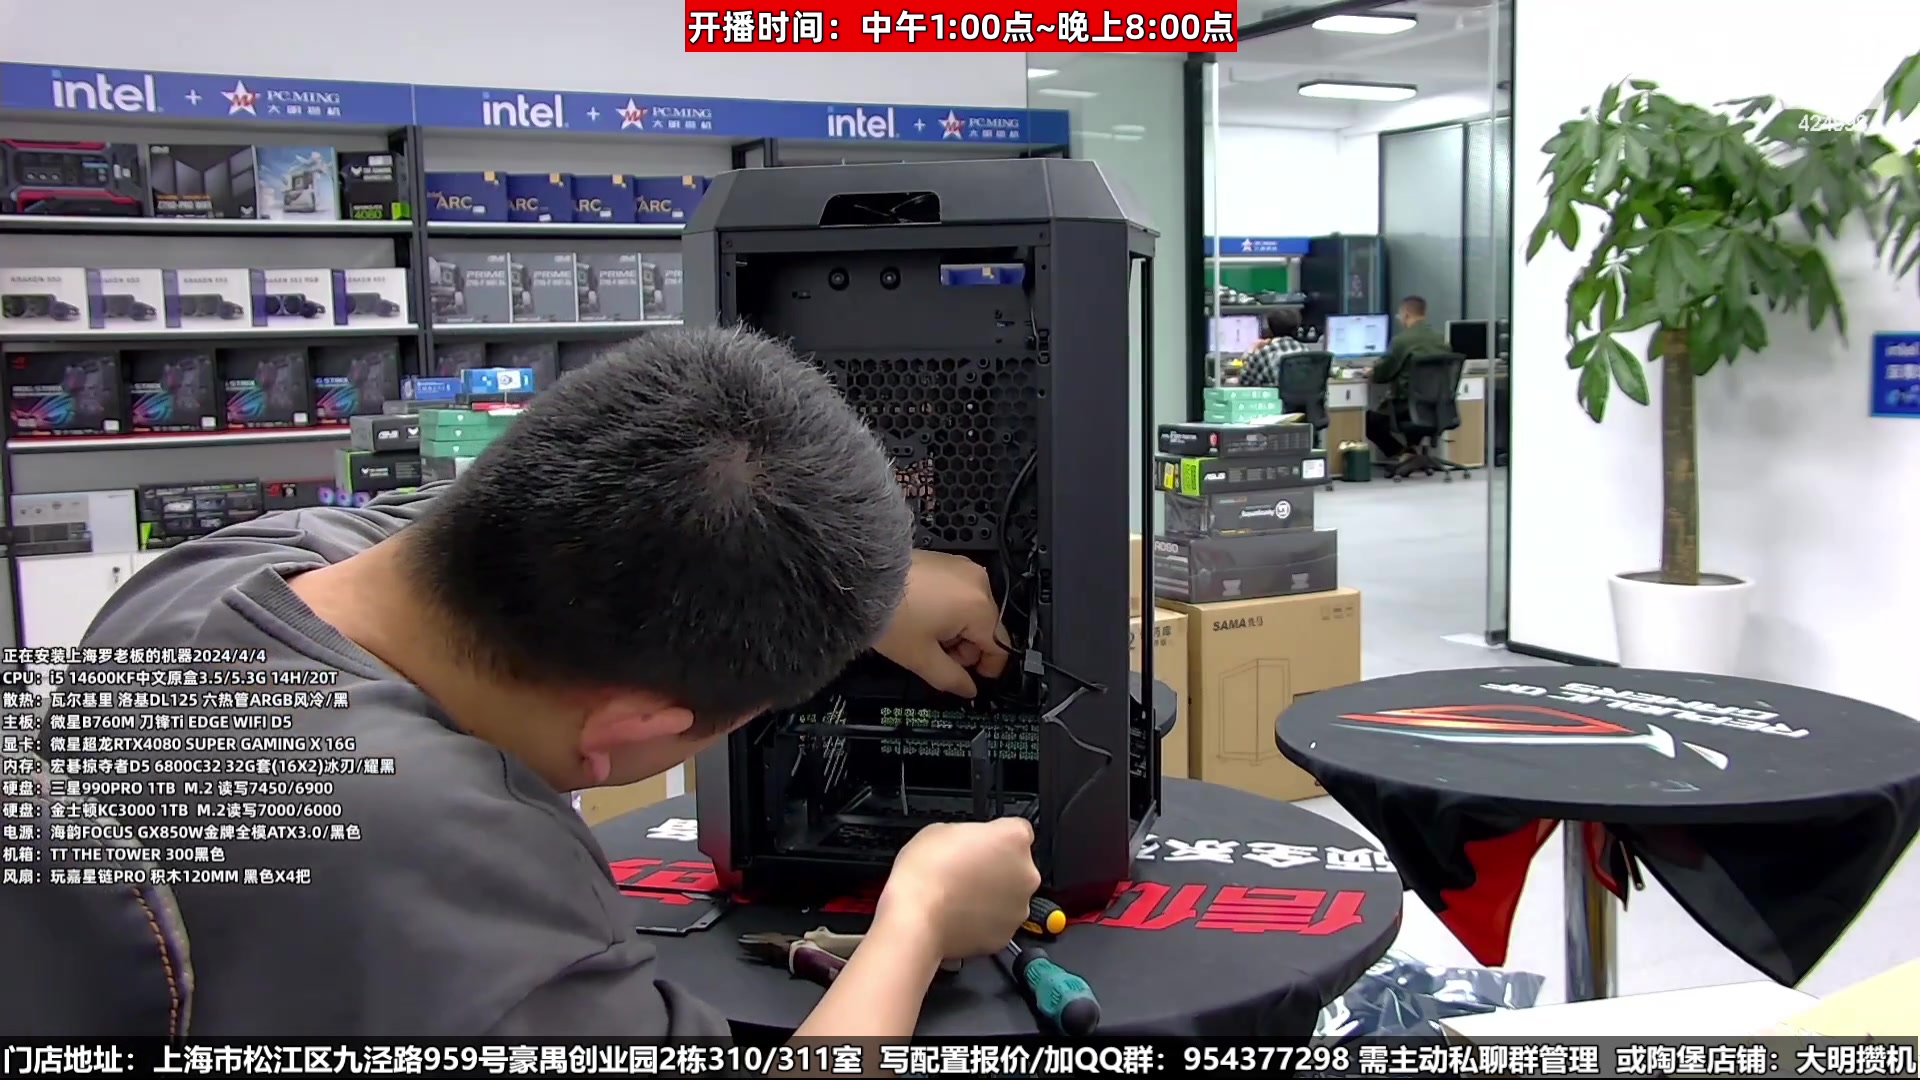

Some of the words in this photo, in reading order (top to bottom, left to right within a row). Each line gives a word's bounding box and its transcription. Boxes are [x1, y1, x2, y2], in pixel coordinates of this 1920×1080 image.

[51, 69, 162, 113] intel
[481, 91, 569, 128] intel
[827, 105, 900, 138] intel
[435, 195, 474, 210] ARC
[574, 198, 603, 213] RC
[637, 199, 673, 214] ARC
[1213, 617, 1247, 632] SAMA
